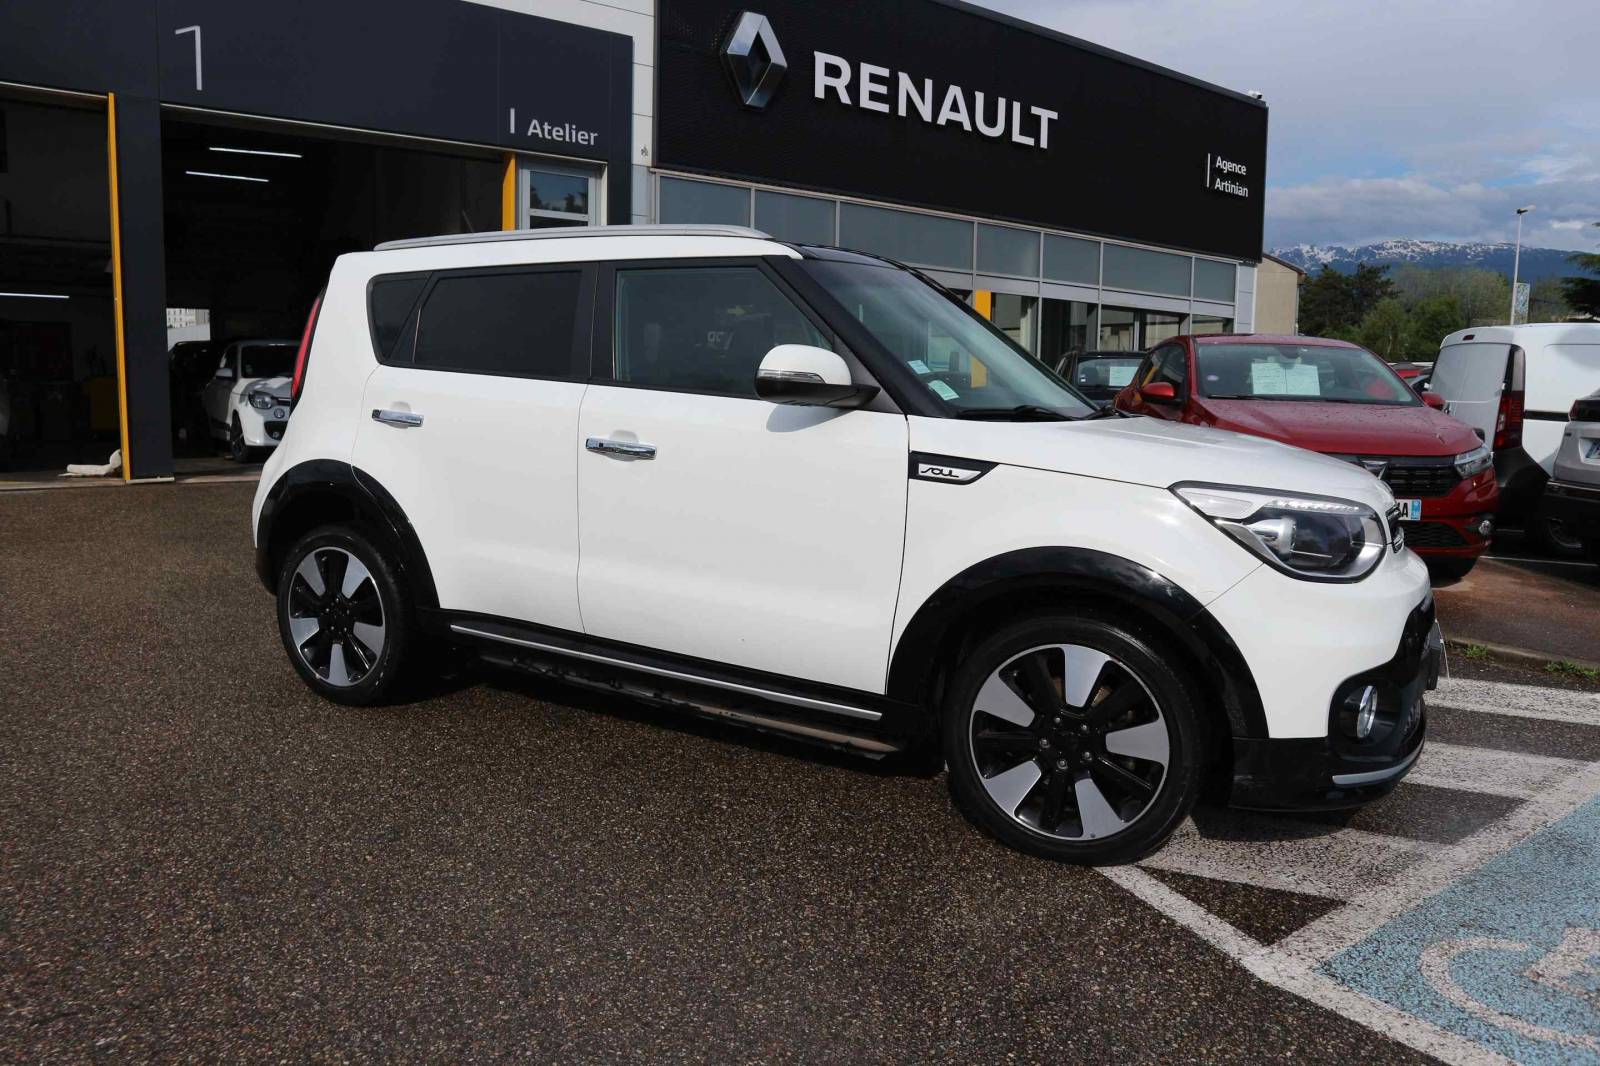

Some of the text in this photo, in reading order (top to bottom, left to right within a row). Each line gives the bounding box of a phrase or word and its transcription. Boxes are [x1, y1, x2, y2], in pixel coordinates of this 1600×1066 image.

[175, 25, 202, 91] 1
[813, 50, 1059, 150] RENAULT
[527, 118, 599, 146] Atelier
[1215, 155, 1247, 176] Agence
[1214, 177, 1249, 198] Artinian
